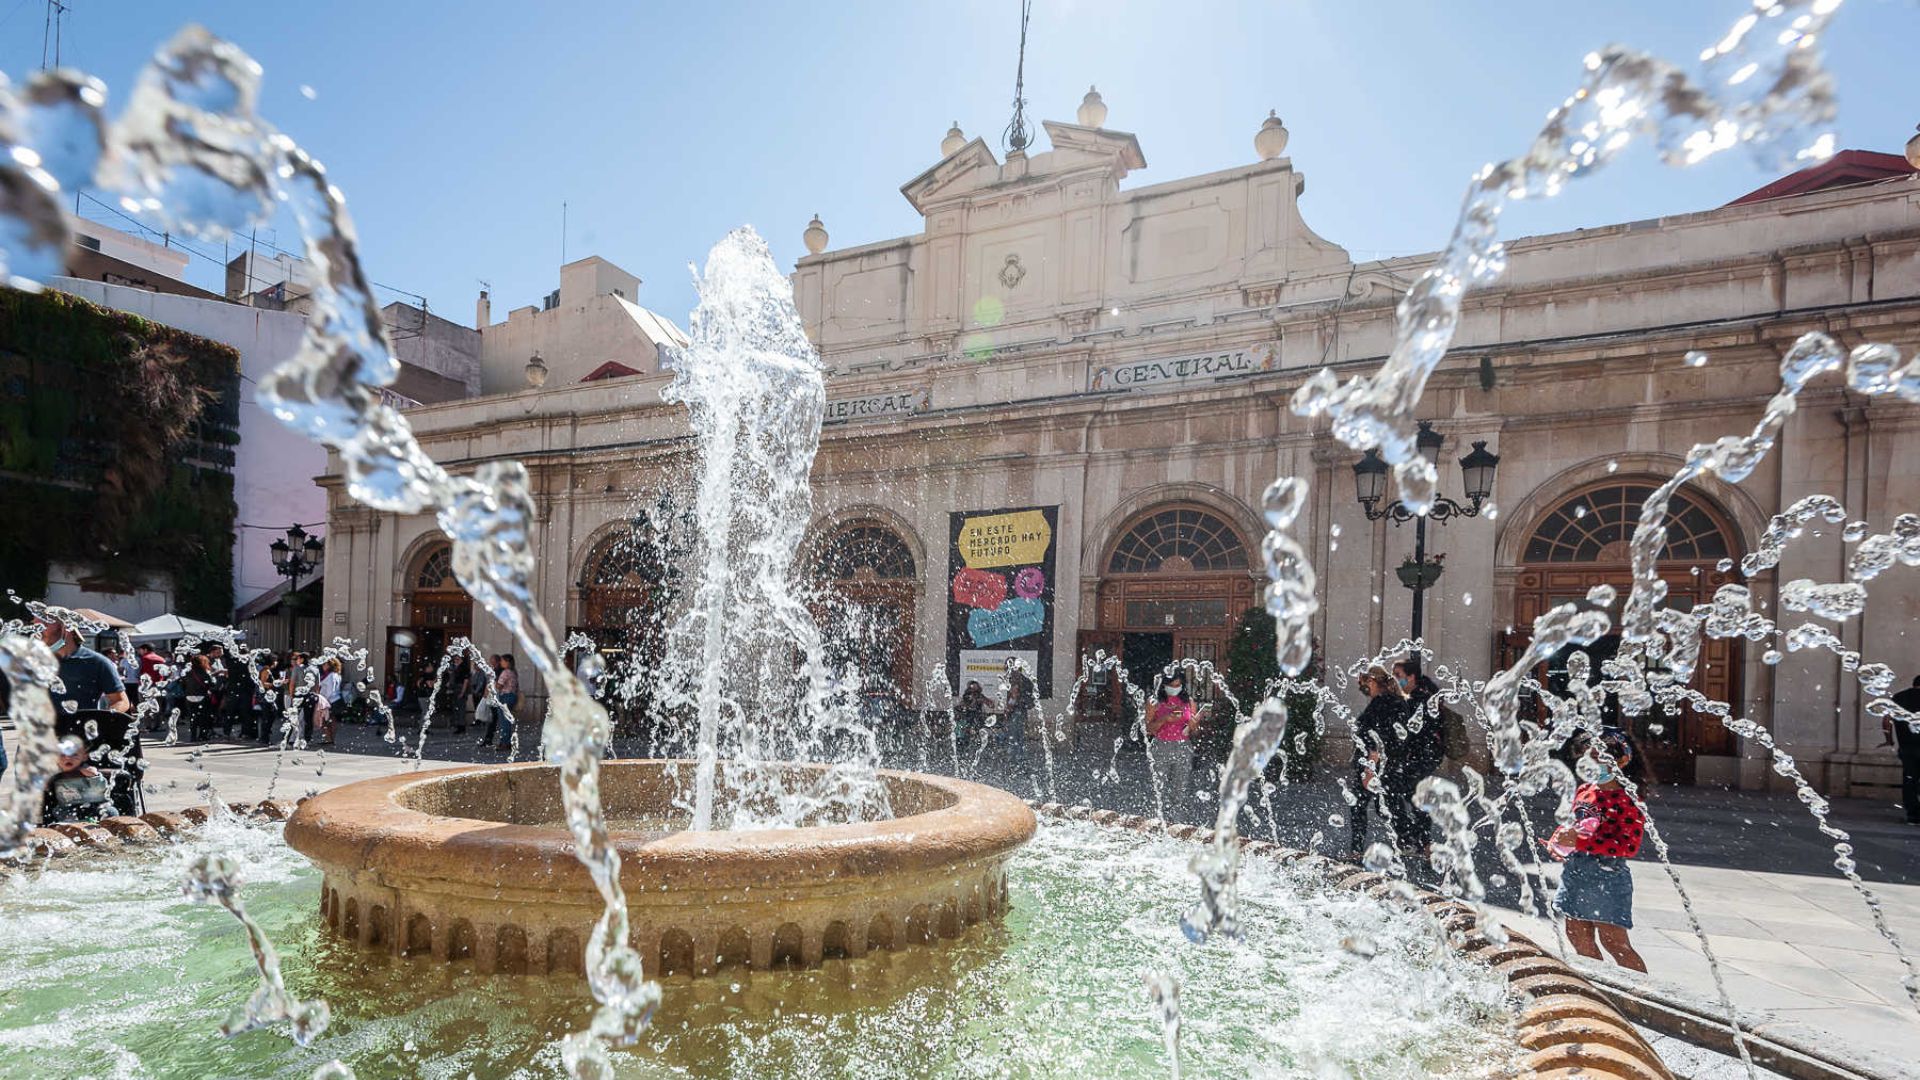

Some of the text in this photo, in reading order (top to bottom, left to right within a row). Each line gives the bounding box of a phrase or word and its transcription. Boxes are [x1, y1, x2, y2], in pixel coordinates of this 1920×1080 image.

[1114, 352, 1251, 385] CENTRAL
[969, 524, 1014, 537] EN ESTE
[970, 531, 1042, 548] MERCADO HAY
[971, 546, 1010, 558] FUTURO
